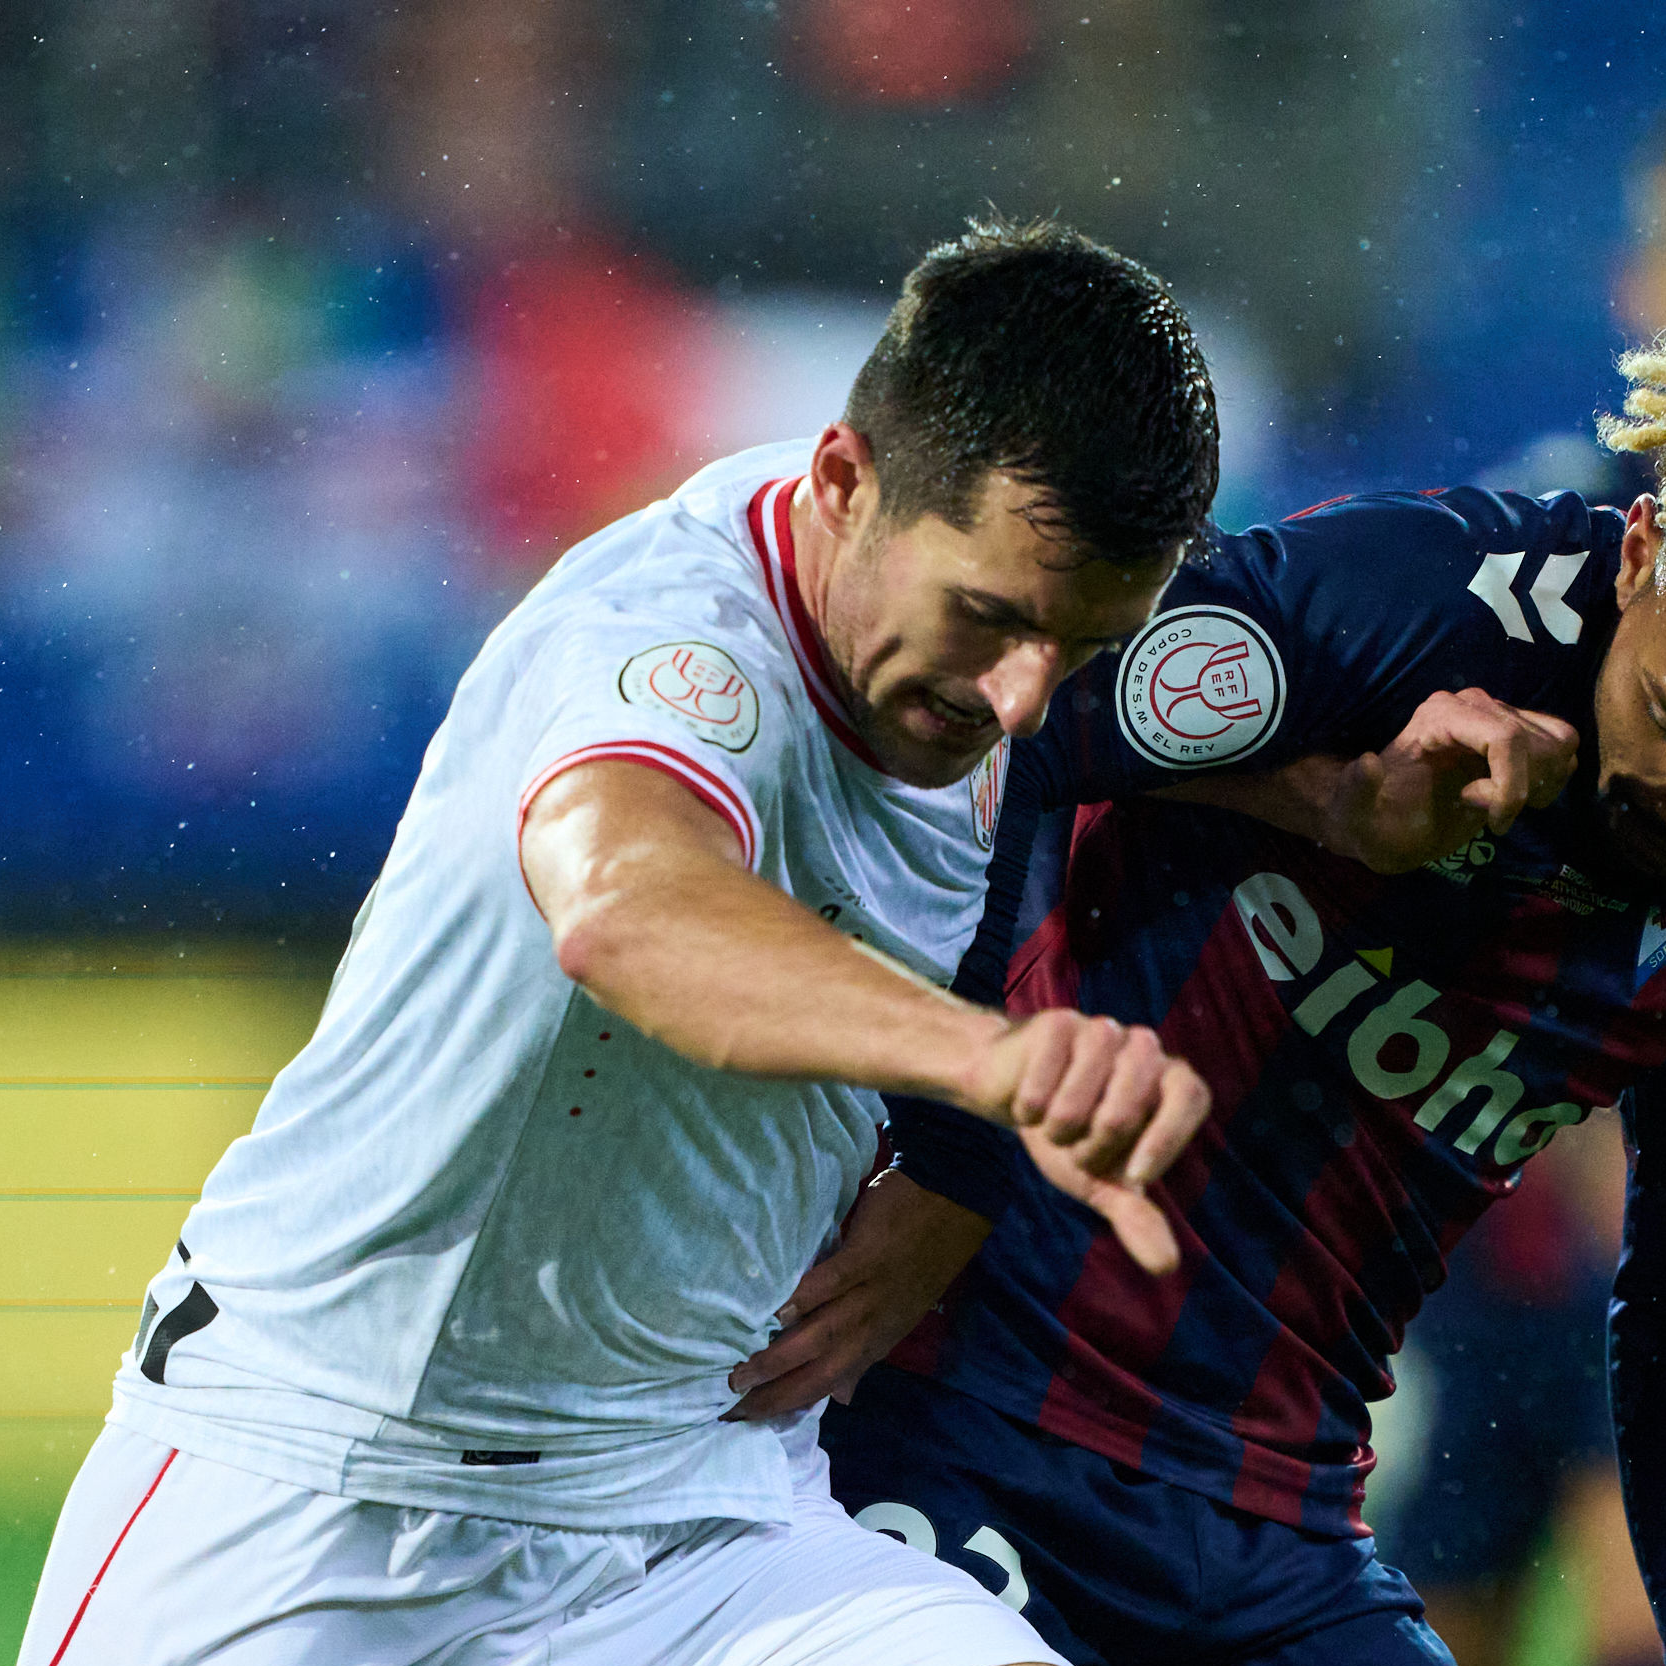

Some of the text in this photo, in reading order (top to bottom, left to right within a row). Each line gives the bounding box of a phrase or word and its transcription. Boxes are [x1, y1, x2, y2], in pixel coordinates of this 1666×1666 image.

[1147, 628, 1192, 657] COPA
[1152, 732, 1172, 750] EL
[1180, 743, 1215, 755] REY
